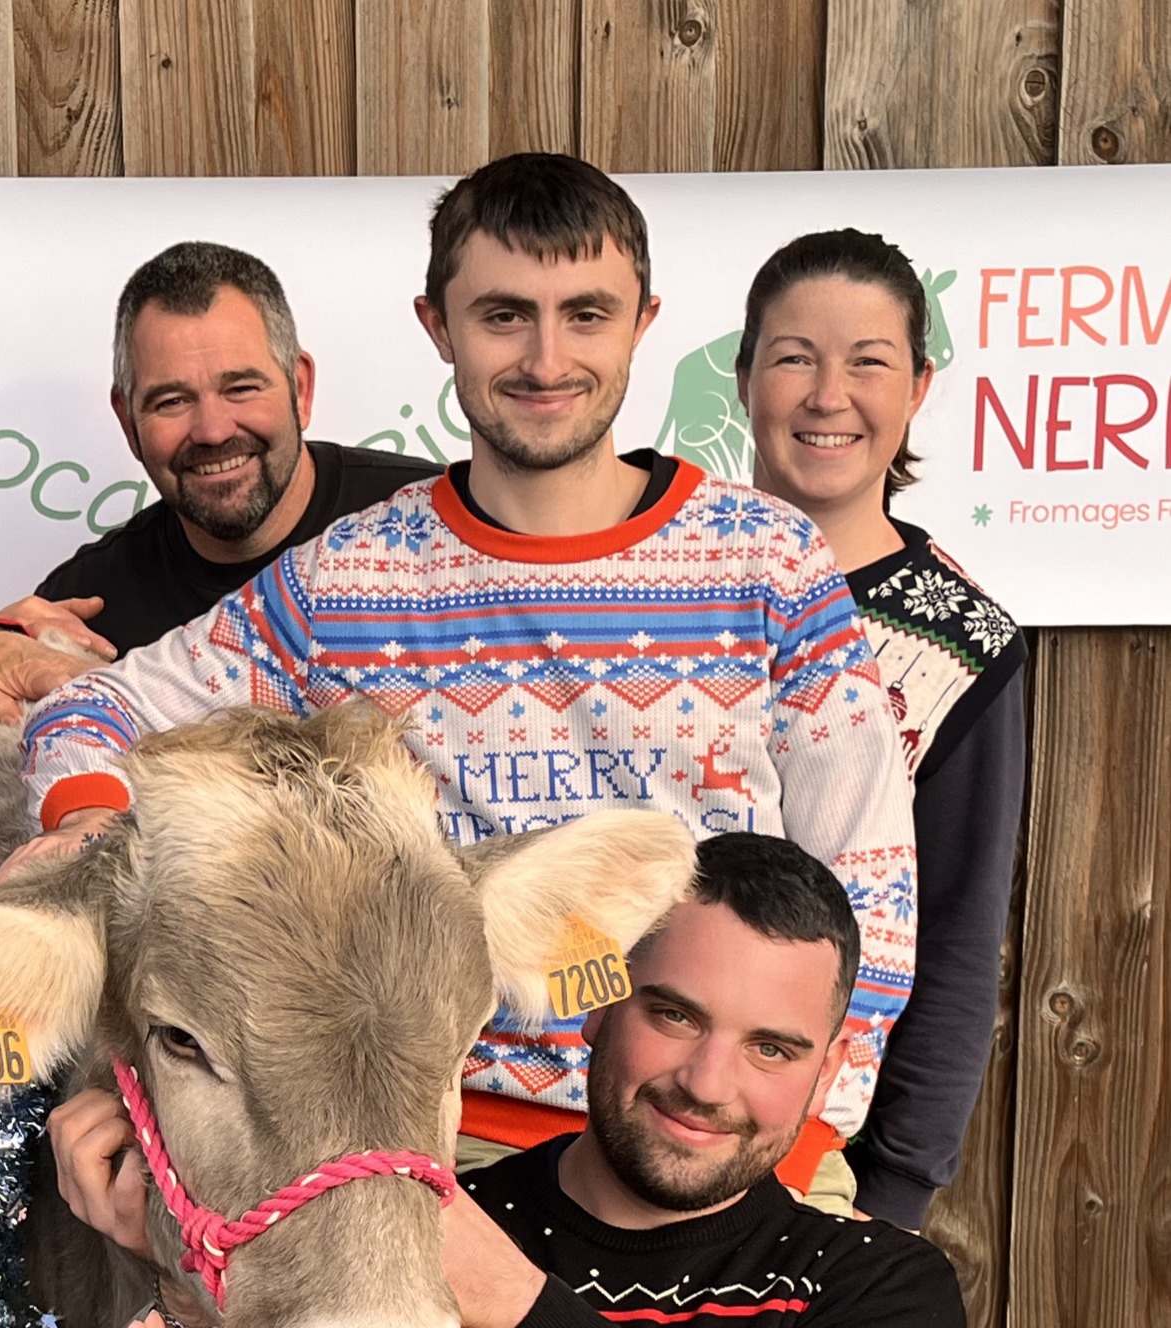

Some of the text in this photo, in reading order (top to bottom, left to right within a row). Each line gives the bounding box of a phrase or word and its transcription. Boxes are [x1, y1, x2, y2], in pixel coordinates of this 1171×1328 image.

[973, 374, 1171, 471] NER
[1009, 500, 1150, 529] Fromages
[453, 747, 667, 804] MERRY
[549, 953, 627, 1017] 7206
